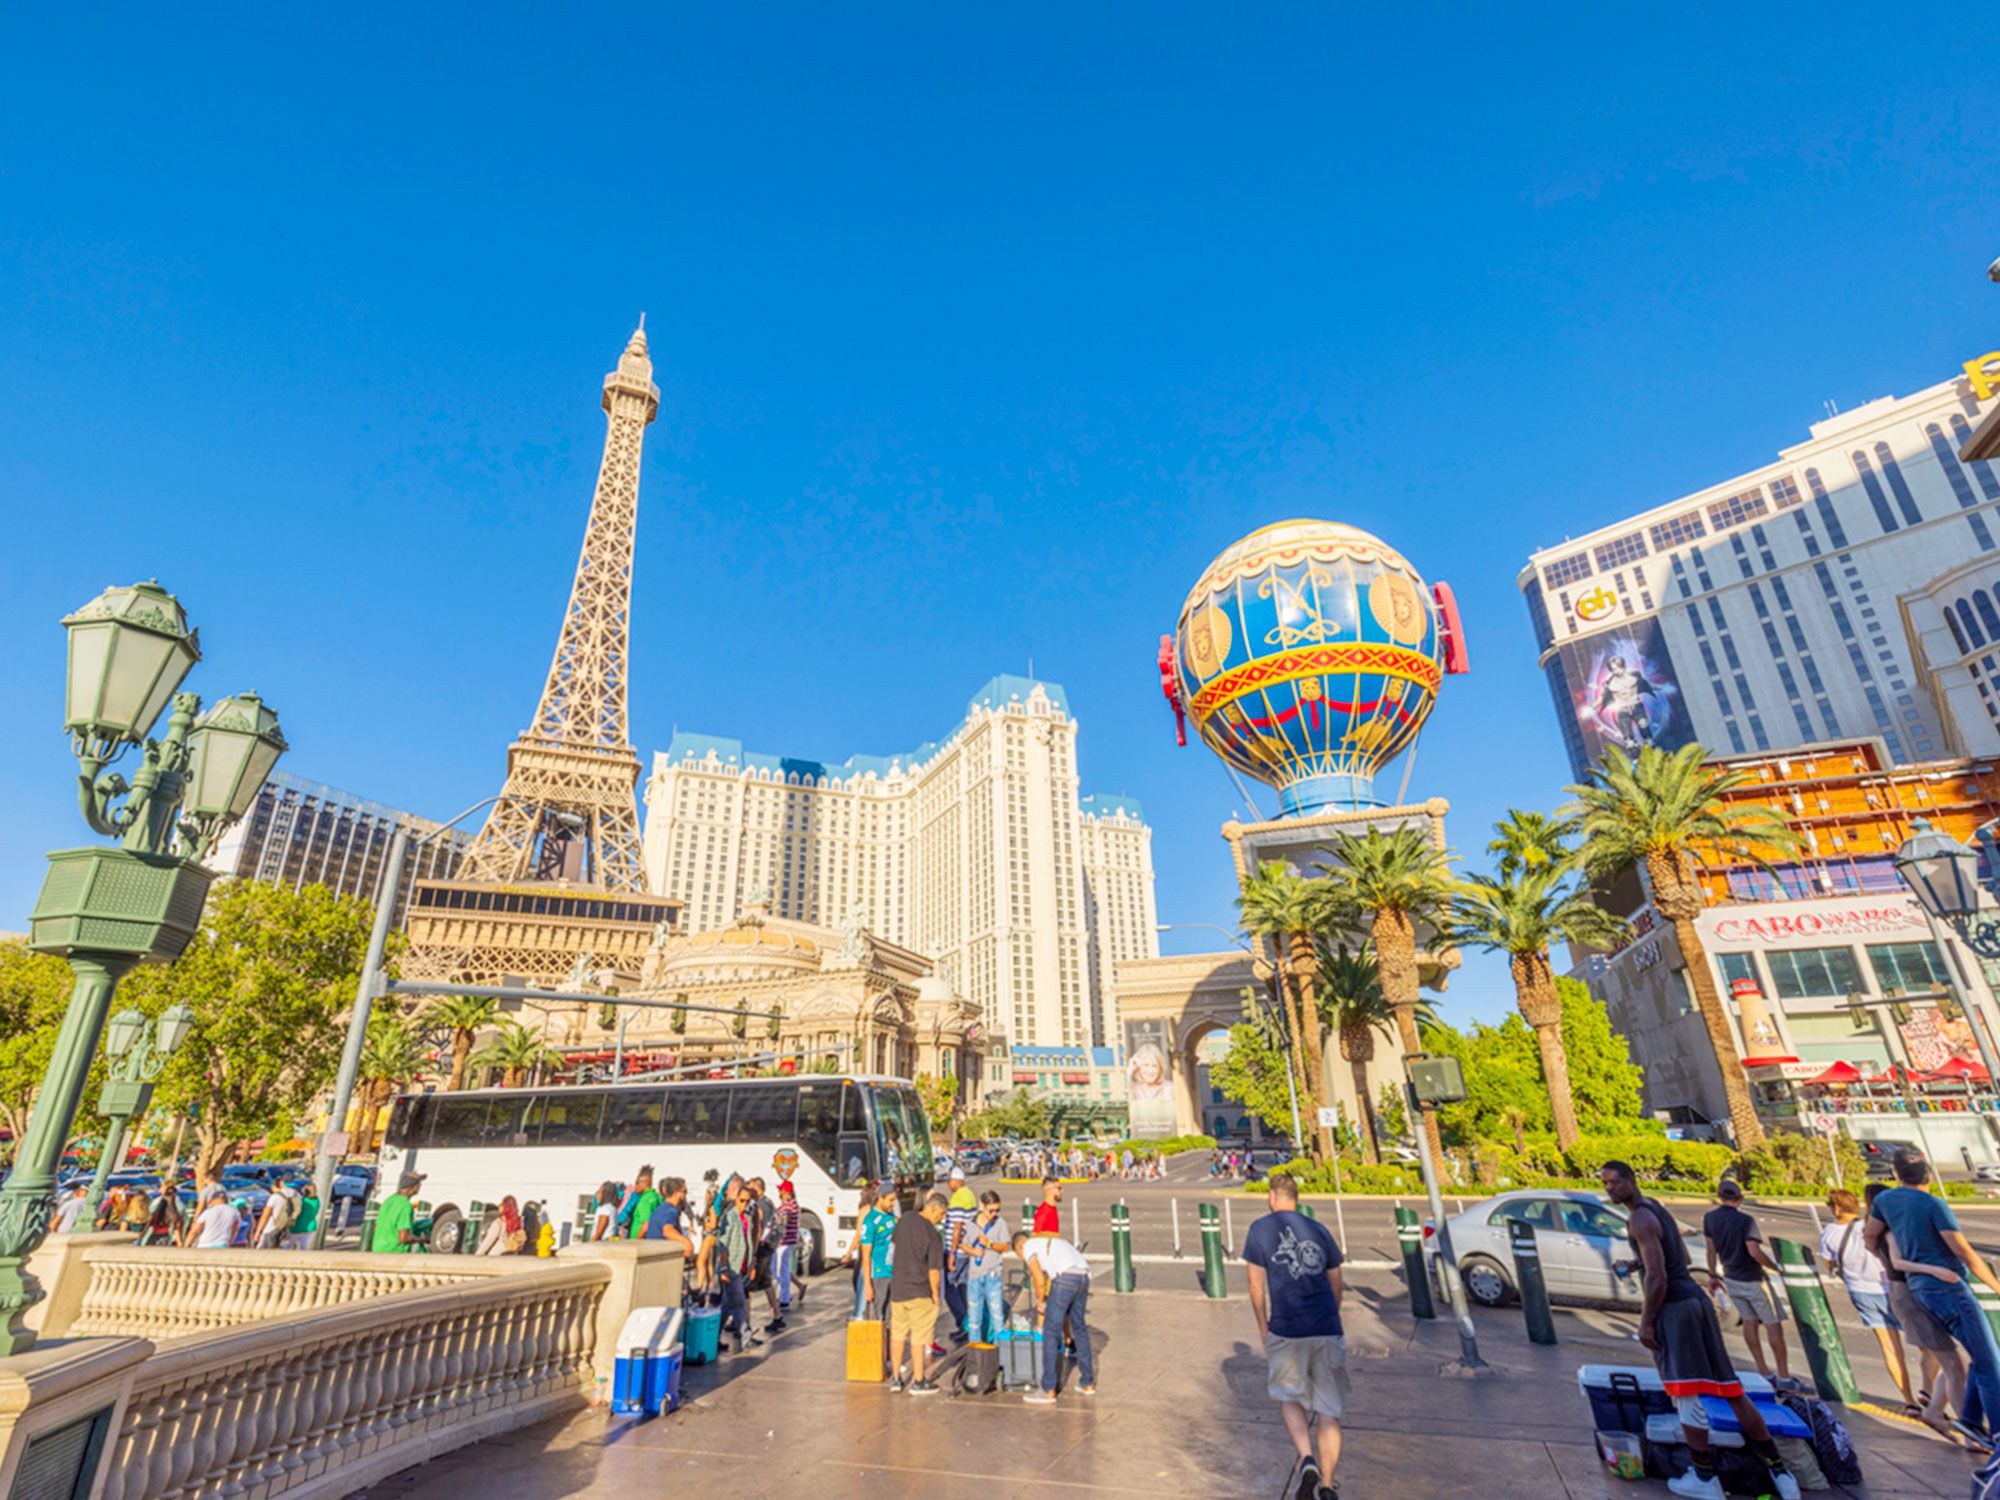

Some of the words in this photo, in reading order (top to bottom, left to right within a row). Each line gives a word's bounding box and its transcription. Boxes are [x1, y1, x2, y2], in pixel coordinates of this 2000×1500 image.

[1580, 586, 1617, 617] ph
[1714, 914, 1822, 943] CABO
[1818, 907, 1902, 928] WABO
